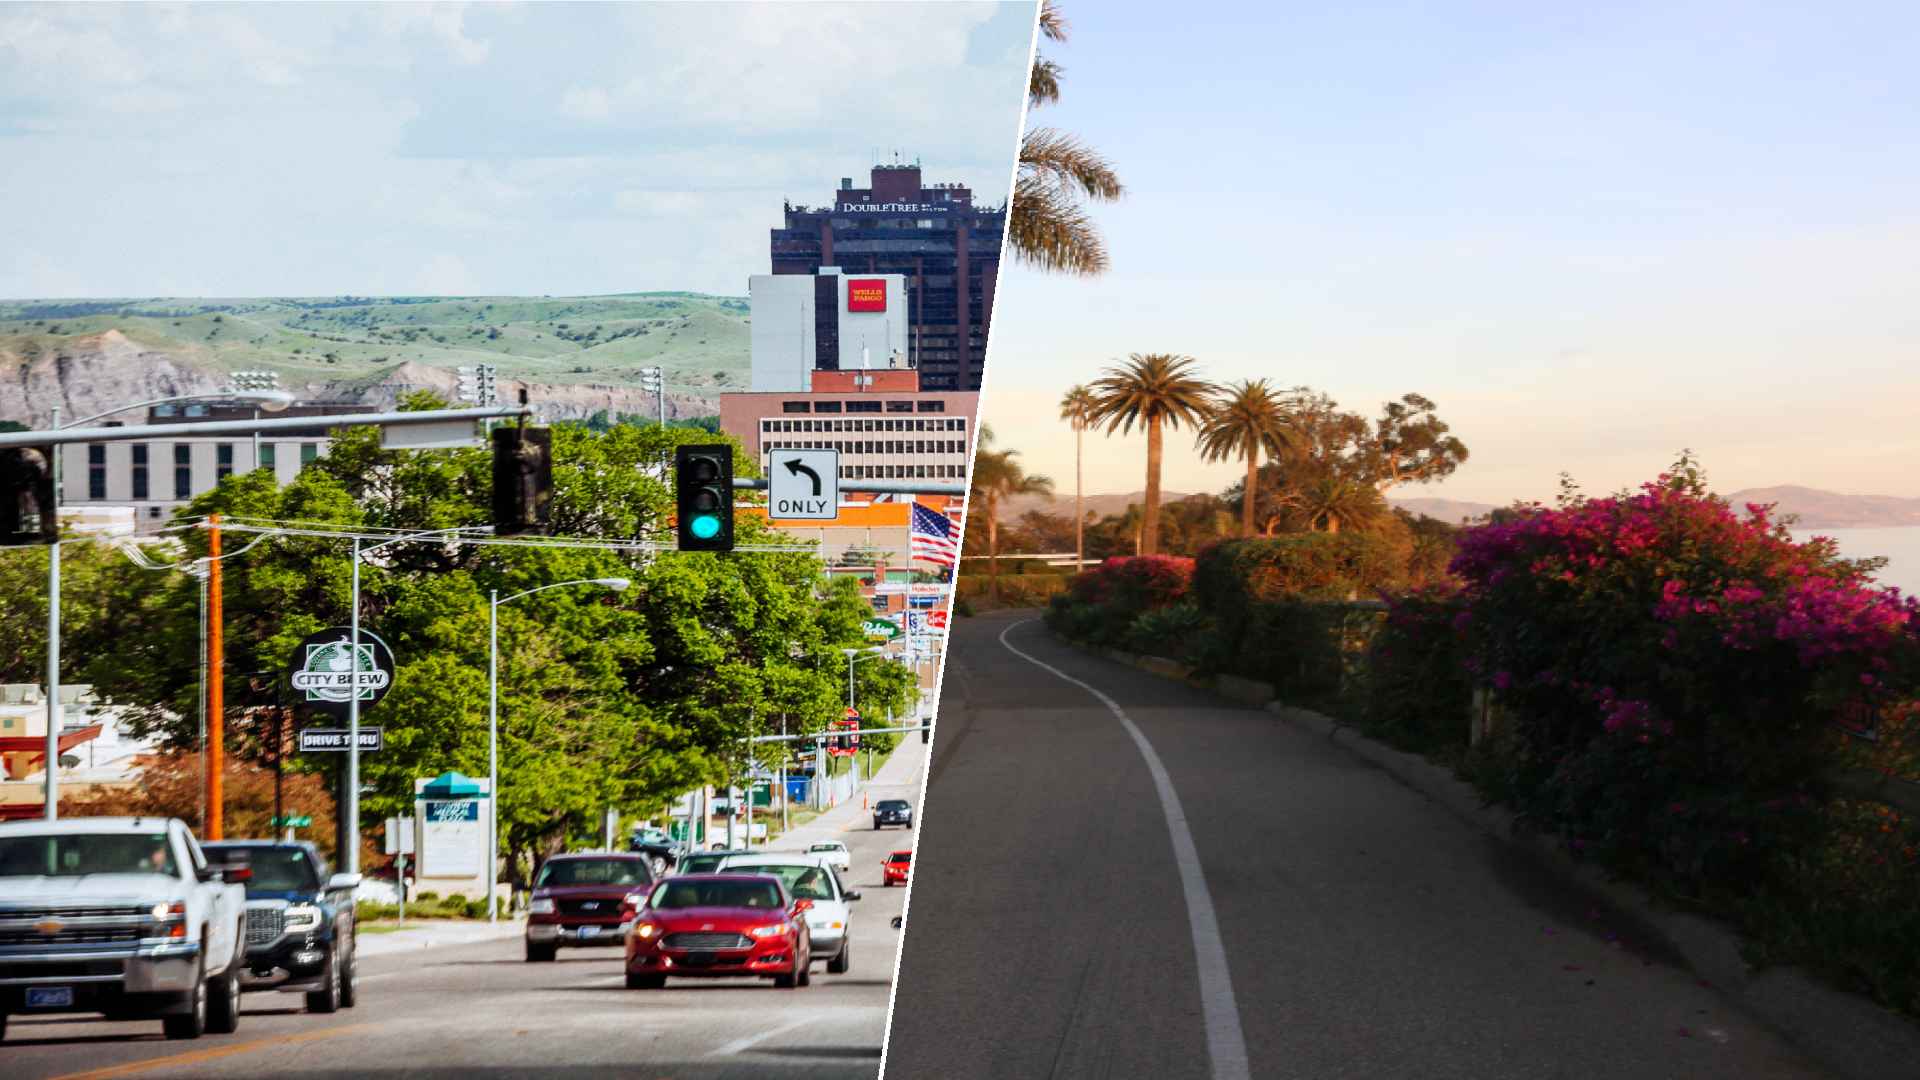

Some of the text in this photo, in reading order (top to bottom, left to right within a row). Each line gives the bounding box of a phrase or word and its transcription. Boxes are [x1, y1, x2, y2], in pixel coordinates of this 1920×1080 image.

[778, 499, 827, 513] ONLY
[297, 674, 332, 685] CITY
[304, 734, 377, 745] DRIVE TRU
